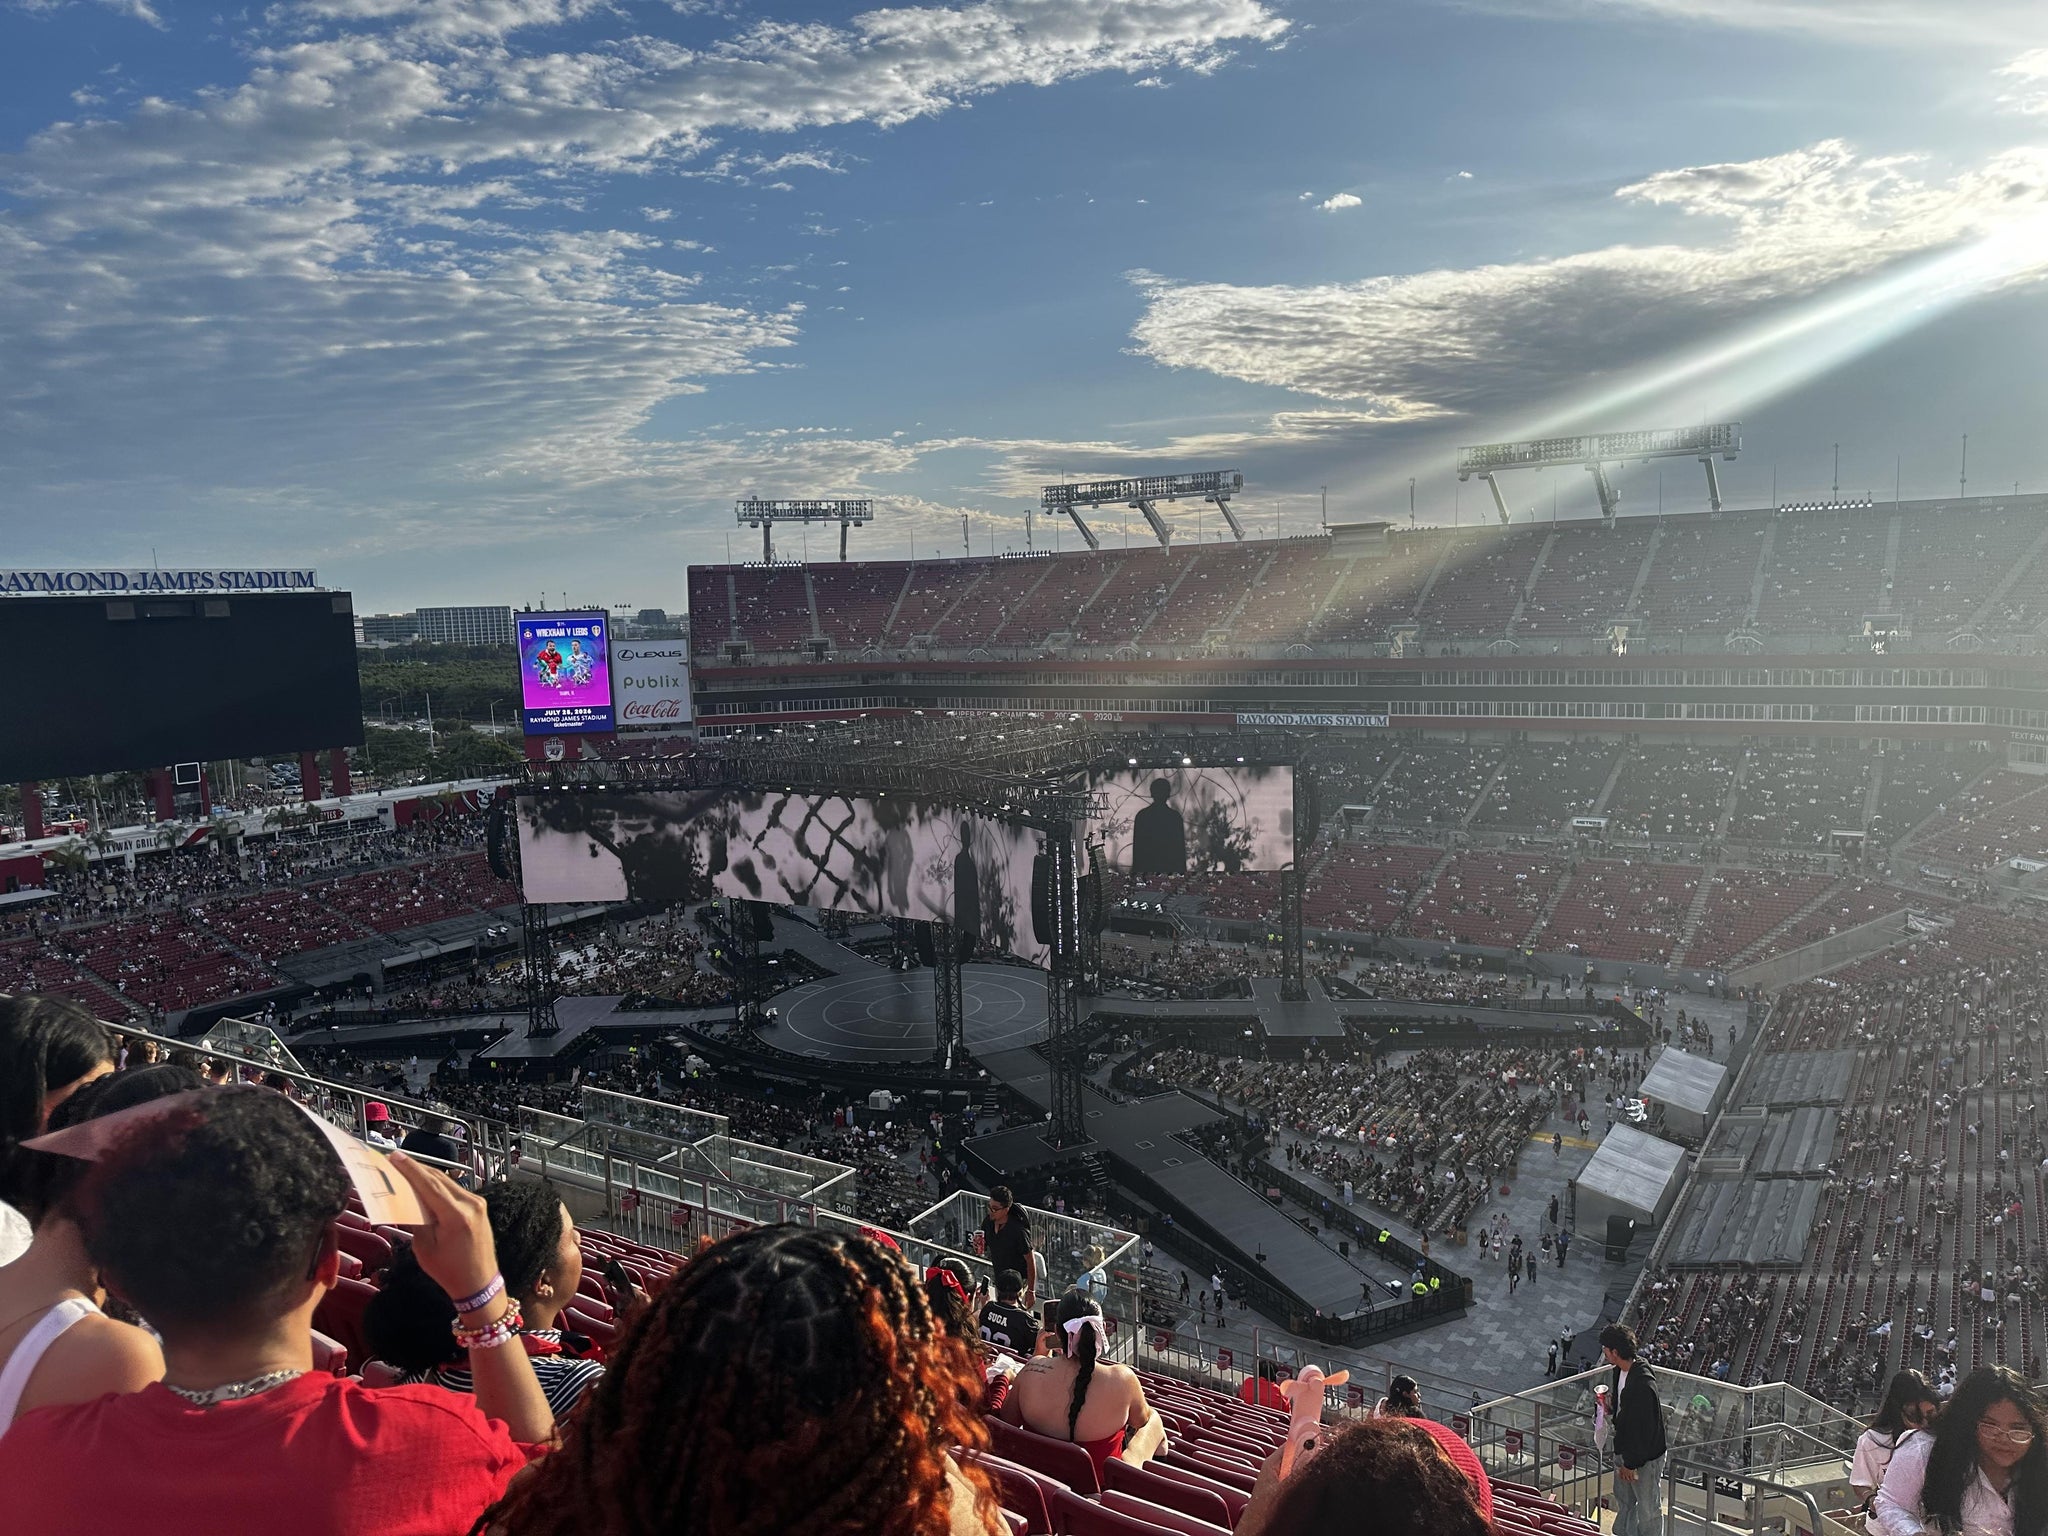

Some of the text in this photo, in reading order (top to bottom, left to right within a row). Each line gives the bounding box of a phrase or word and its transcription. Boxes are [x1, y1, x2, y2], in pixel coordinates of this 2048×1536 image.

[132, 571, 215, 591] JAMES
[218, 571, 315, 589] STADIUM
[566, 628, 571, 637] V
[572, 627, 589, 636] LEEDS
[635, 650, 682, 659] LEXUS
[623, 675, 680, 690] Publix
[544, 709, 561, 717] JULY
[623, 699, 682, 720] Coca-Cola
[1093, 712, 1113, 721] 2020
[1238, 714, 1388, 726] RAYMOND JAMES STADIUM
[2009, 731, 2029, 740] TEXT
[835, 1202, 852, 1215] 340
[987, 1310, 1008, 1328] SUGA
